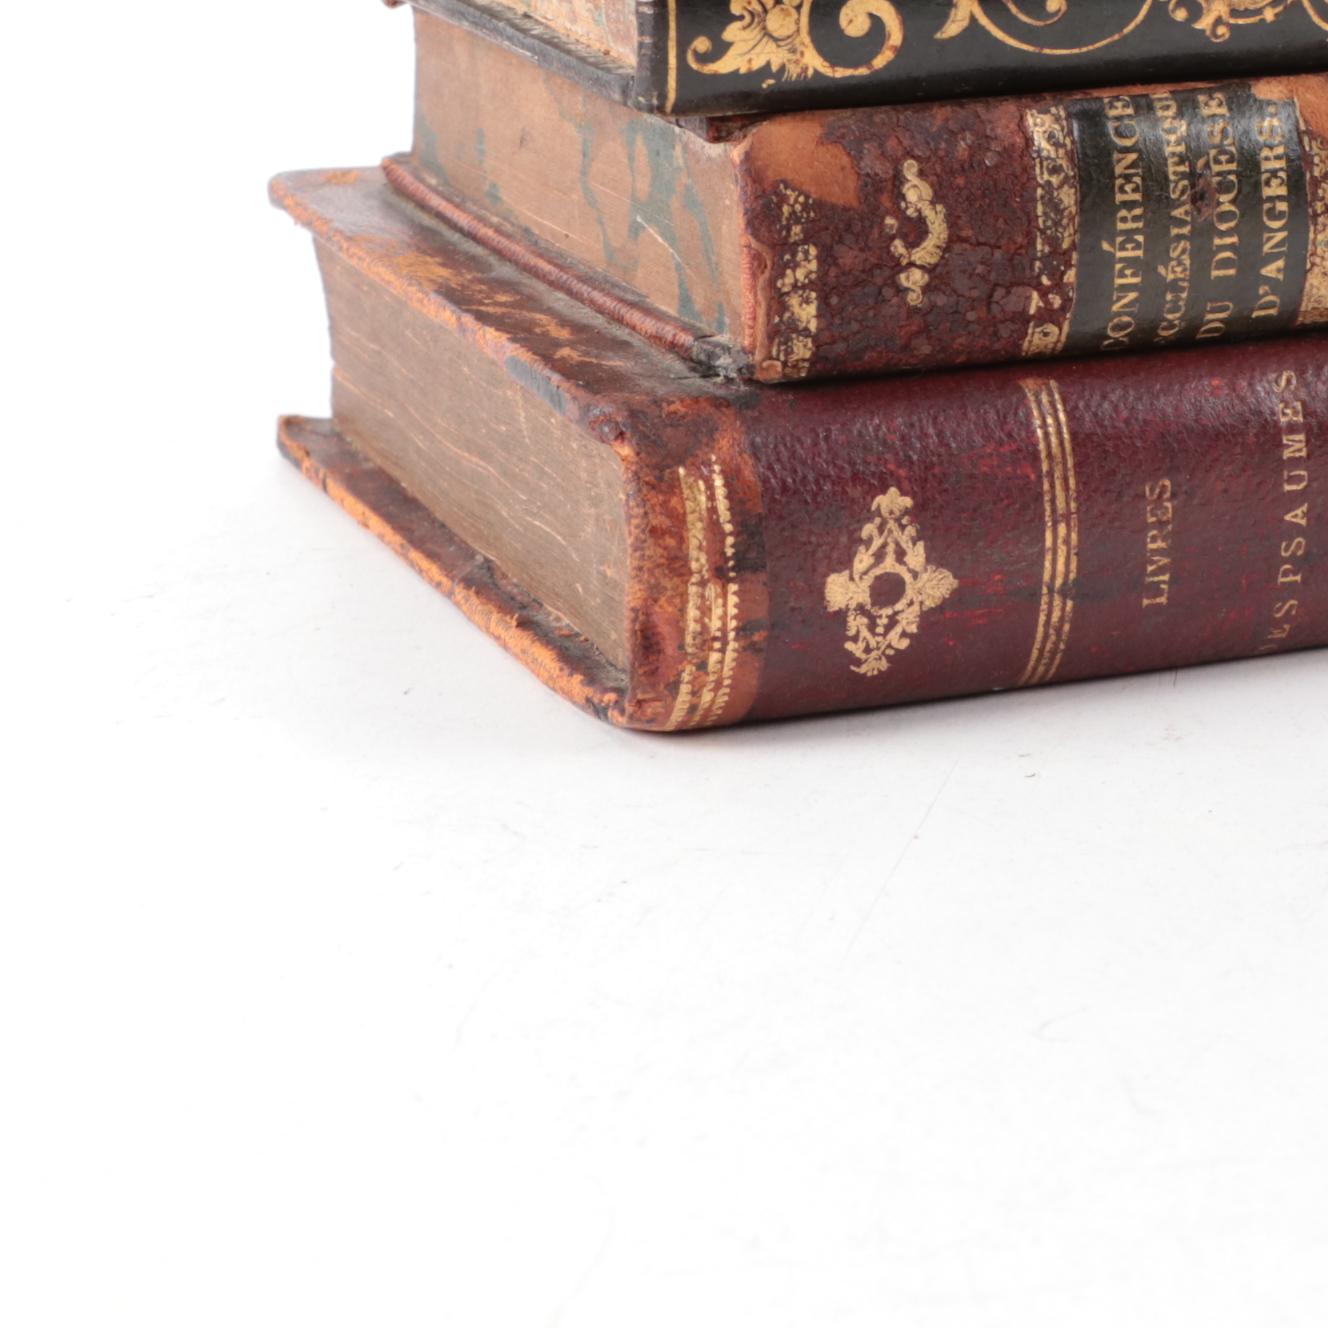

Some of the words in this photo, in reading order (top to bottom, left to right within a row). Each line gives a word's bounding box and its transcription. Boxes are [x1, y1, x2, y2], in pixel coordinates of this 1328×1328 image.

[1197, 92, 1241, 279] DIOCÈSE
[1196, 300, 1233, 340] DU
[1142, 478, 1174, 608] LIVRES
[1273, 370, 1308, 585] PSAUMES
